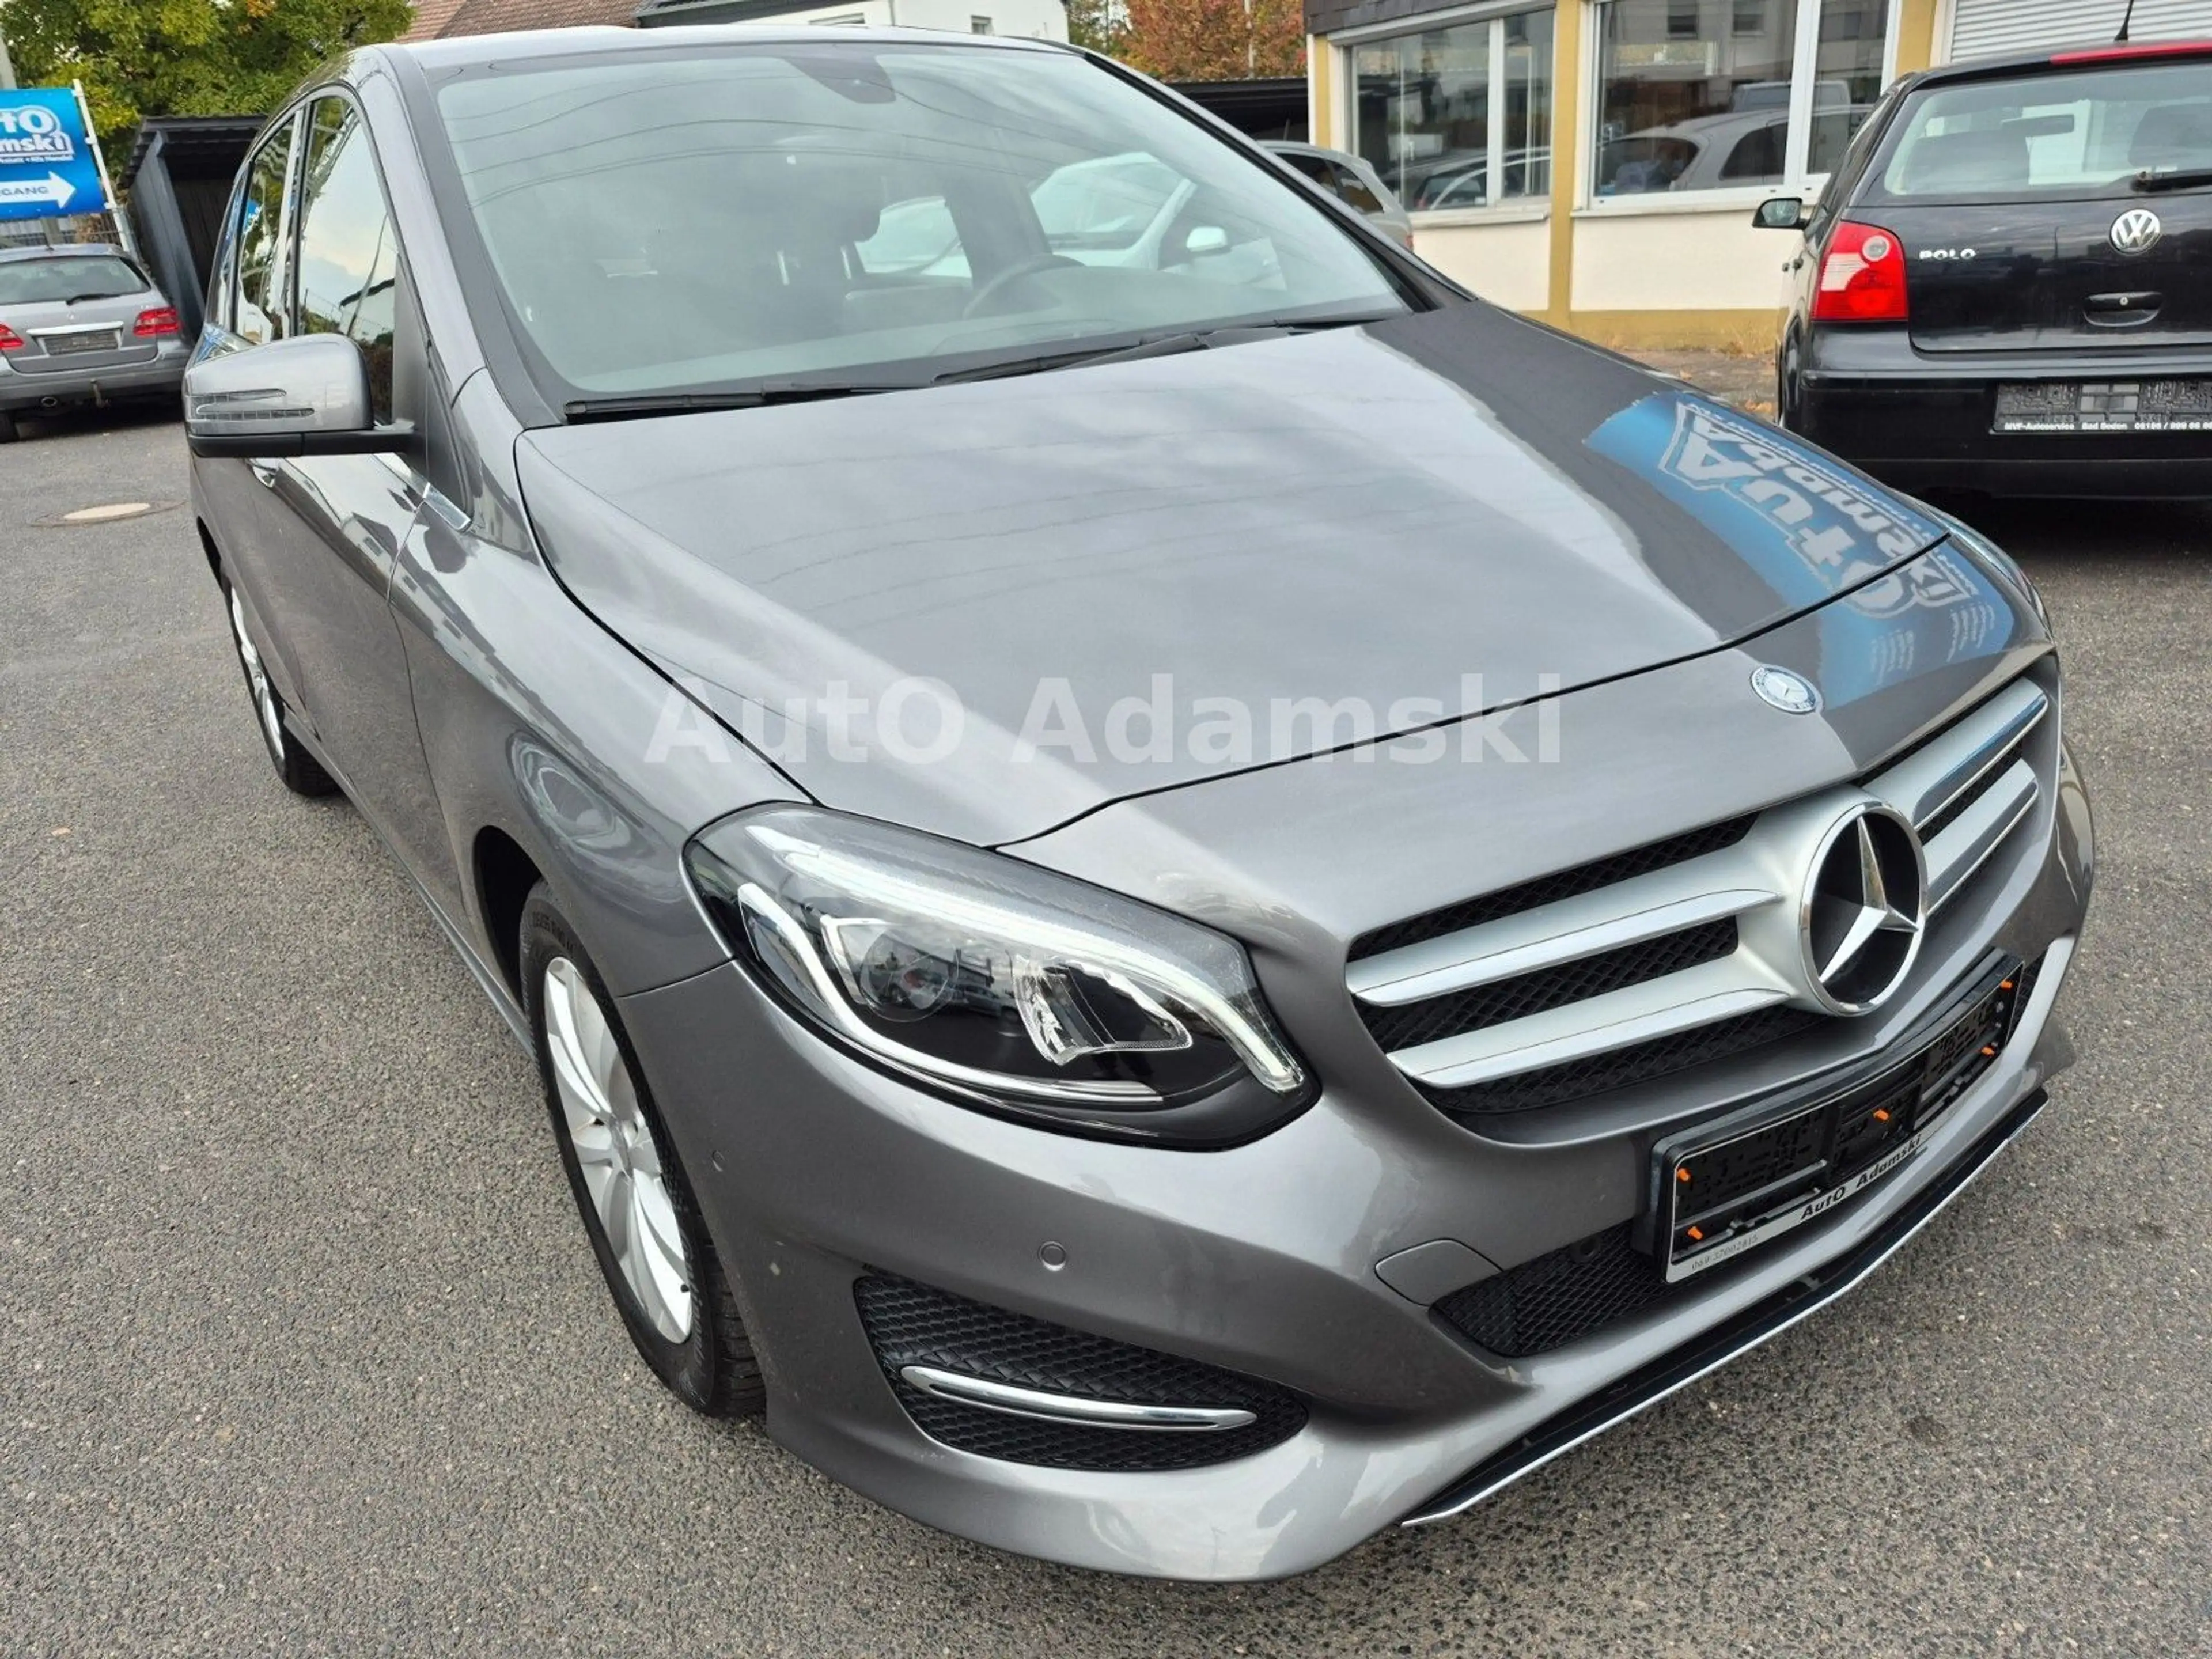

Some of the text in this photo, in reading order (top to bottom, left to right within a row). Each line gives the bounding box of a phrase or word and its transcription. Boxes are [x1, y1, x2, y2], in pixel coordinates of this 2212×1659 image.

[0, 186, 50, 196] GANG
[1918, 248, 1976, 260] POLO
[1800, 1133, 1922, 1220] AutO Adamski
